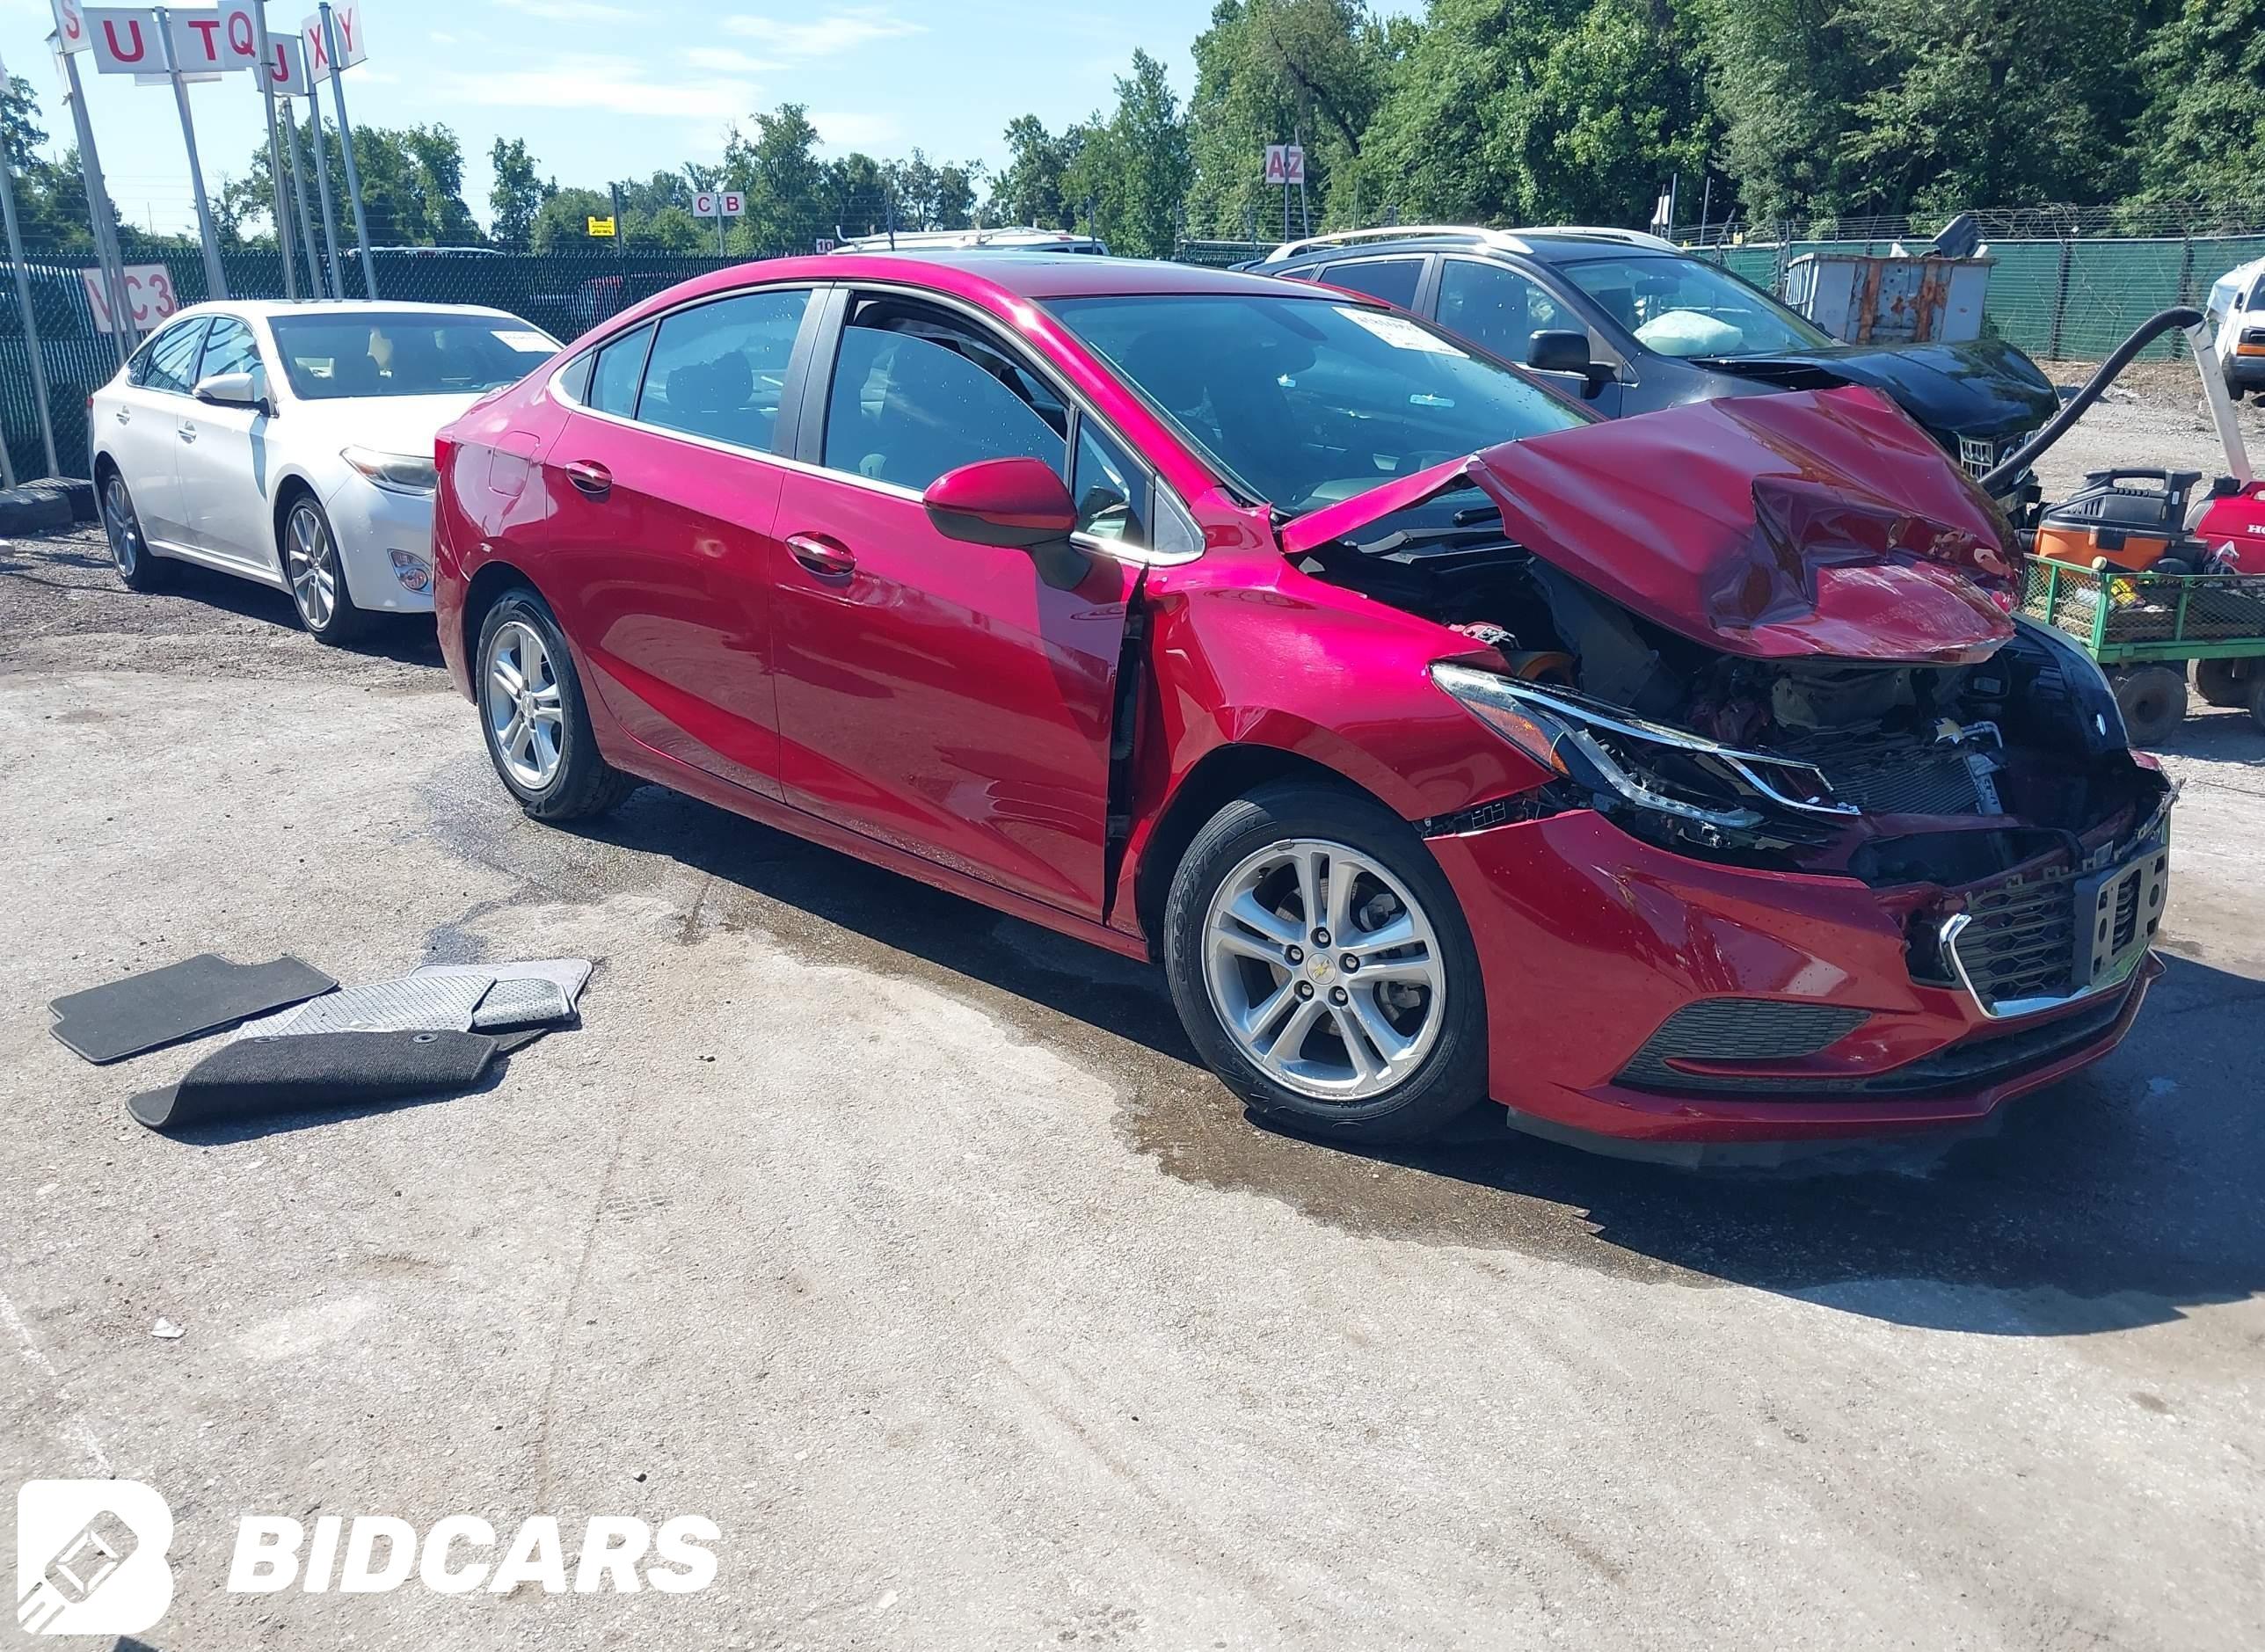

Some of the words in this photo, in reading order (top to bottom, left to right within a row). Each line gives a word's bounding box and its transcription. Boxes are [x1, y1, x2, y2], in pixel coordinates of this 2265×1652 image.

[61, 0, 80, 40] S
[187, 20, 220, 61] T
[228, 11, 256, 58] Q
[338, 8, 352, 53] Y
[103, 20, 144, 62] U
[309, 24, 328, 69] X
[271, 44, 289, 82] J
[697, 197, 710, 212] C
[726, 197, 739, 211] B
[818, 241, 833, 252] 10
[1174, 816, 1258, 983] GOODYEAR
